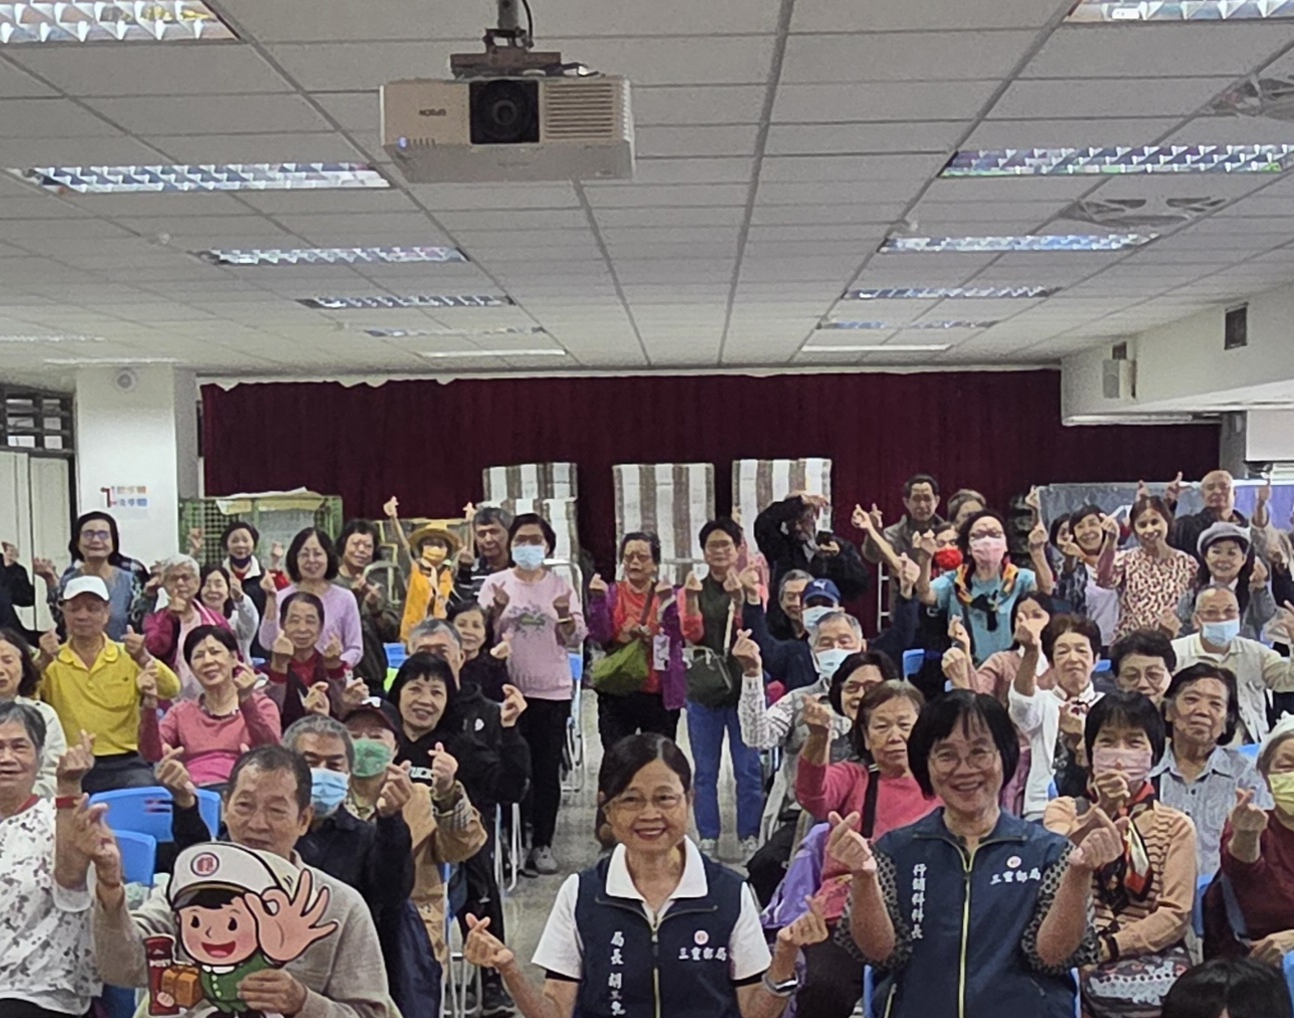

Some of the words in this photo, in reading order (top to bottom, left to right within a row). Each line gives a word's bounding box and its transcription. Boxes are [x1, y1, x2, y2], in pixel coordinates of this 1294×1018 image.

[989, 867, 1041, 885] 三重郵局
[610, 931, 625, 965] 局長
[678, 946, 727, 961] 三重郵局
